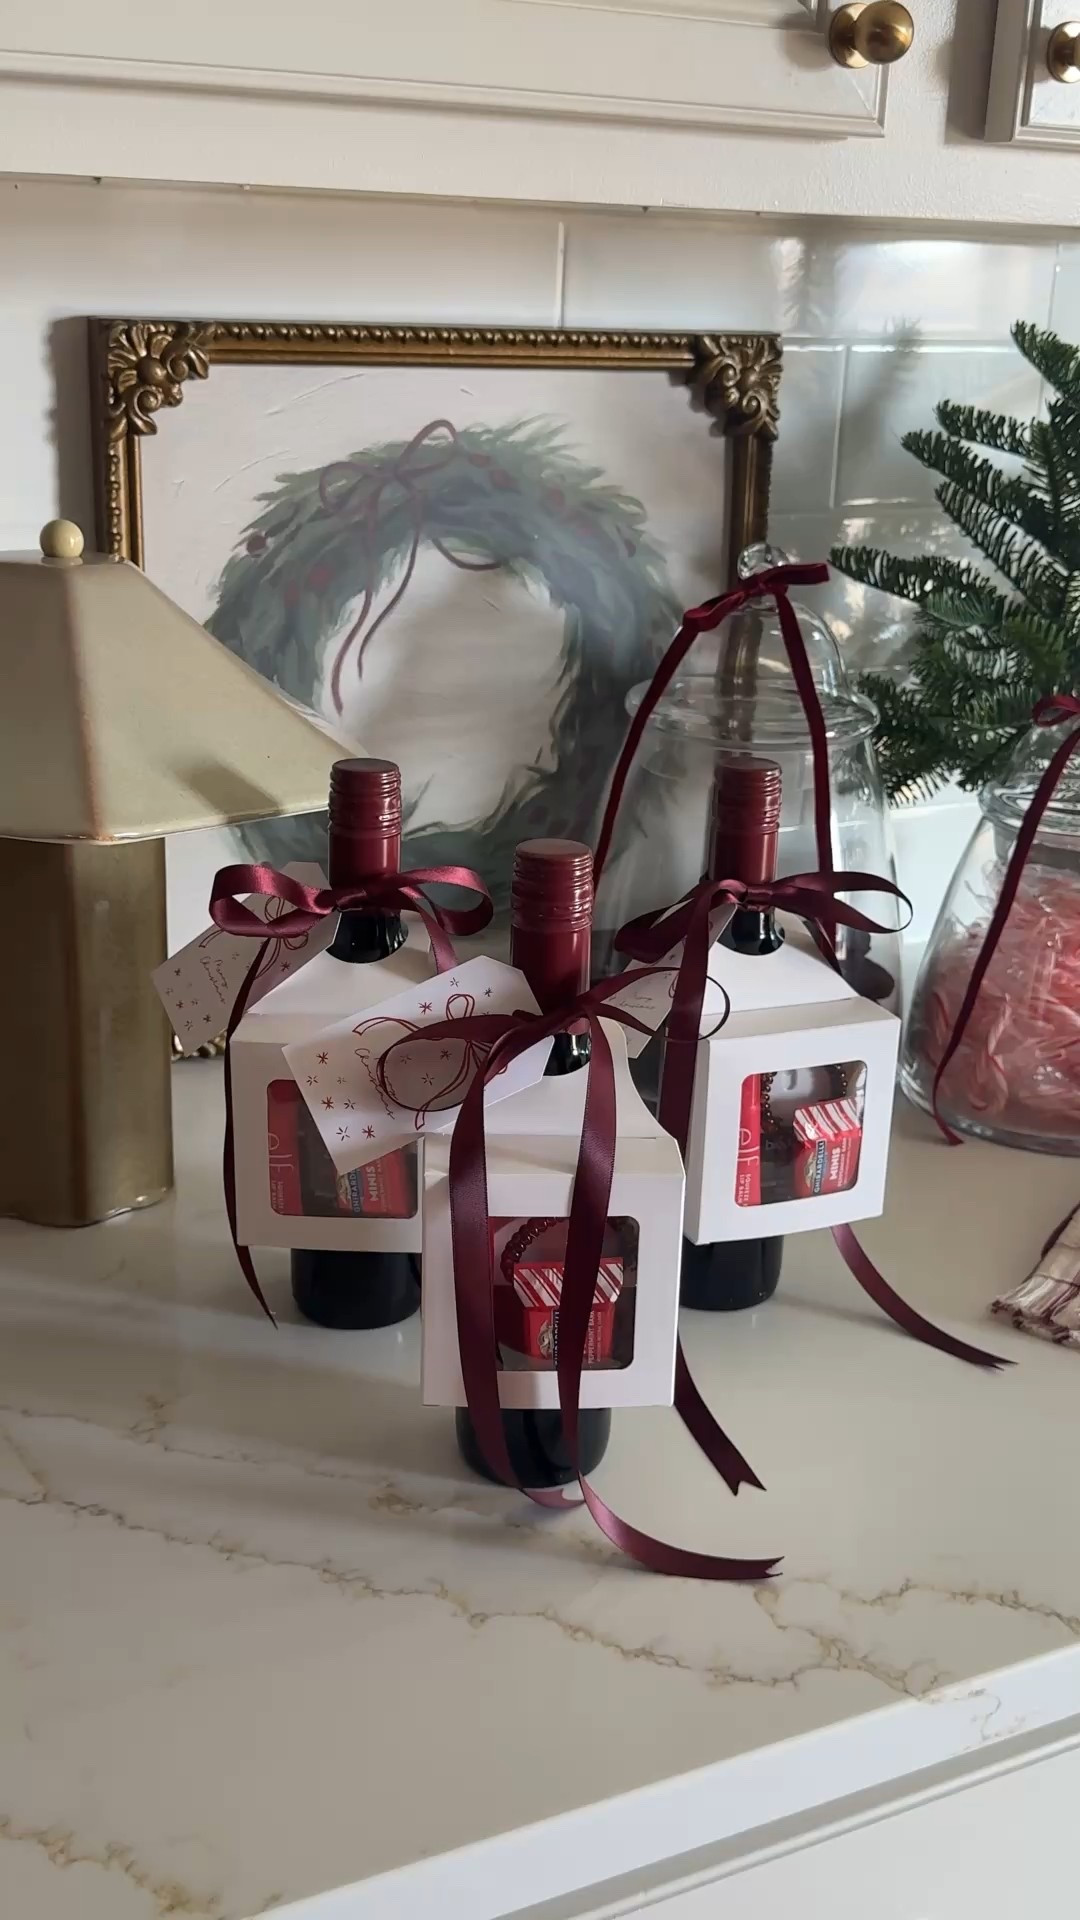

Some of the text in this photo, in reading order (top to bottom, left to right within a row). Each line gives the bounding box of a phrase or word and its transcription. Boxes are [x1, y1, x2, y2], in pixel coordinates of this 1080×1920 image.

[814, 1141, 825, 1194] GHIRARDELLI
[829, 1147, 841, 1181] MINIS
[349, 1169, 362, 1213] GHIRARD
[365, 1165, 379, 1202] MINIS
[587, 1326, 595, 1364] PEPPERMINT
